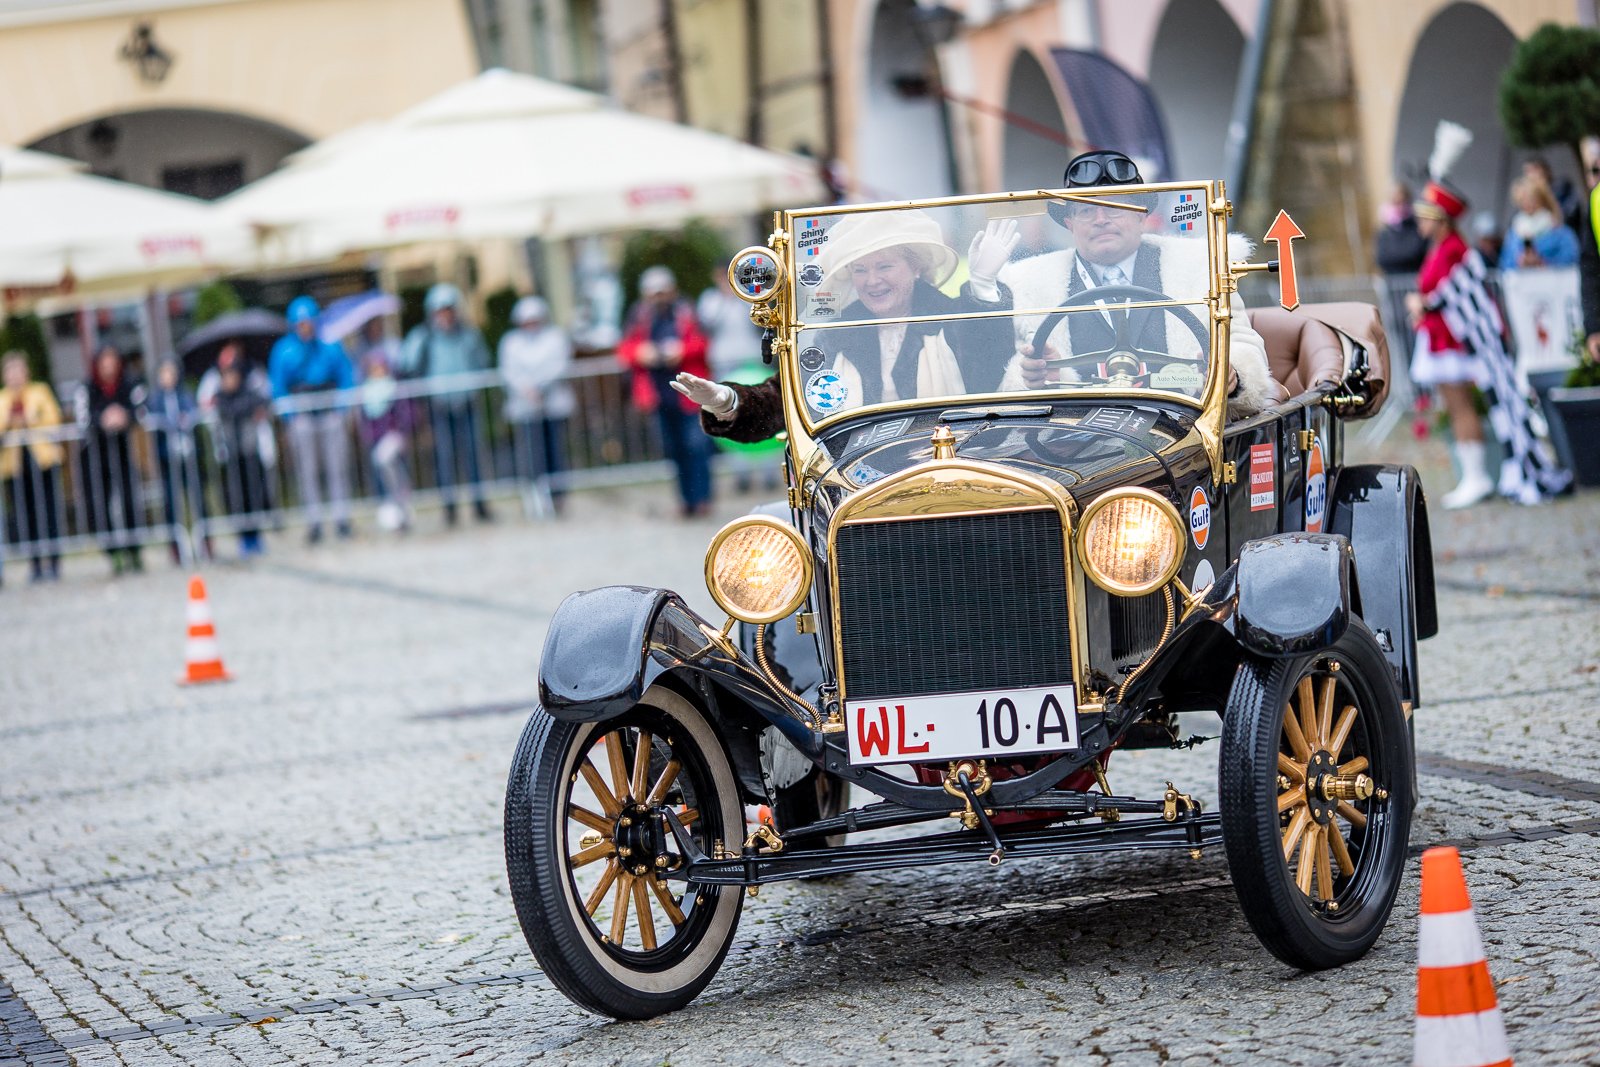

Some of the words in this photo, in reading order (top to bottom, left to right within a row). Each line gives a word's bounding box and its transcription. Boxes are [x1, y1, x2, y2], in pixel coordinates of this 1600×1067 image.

[1174, 202, 1199, 215] Shiny
[1170, 209, 1203, 223] Garage
[801, 228, 825, 241] Shiny
[798, 234, 829, 249] Garage
[744, 266, 768, 276] Shiny
[740, 275, 771, 285] Garage
[1306, 483, 1325, 517] Gulf
[1191, 508, 1209, 529] Gulf
